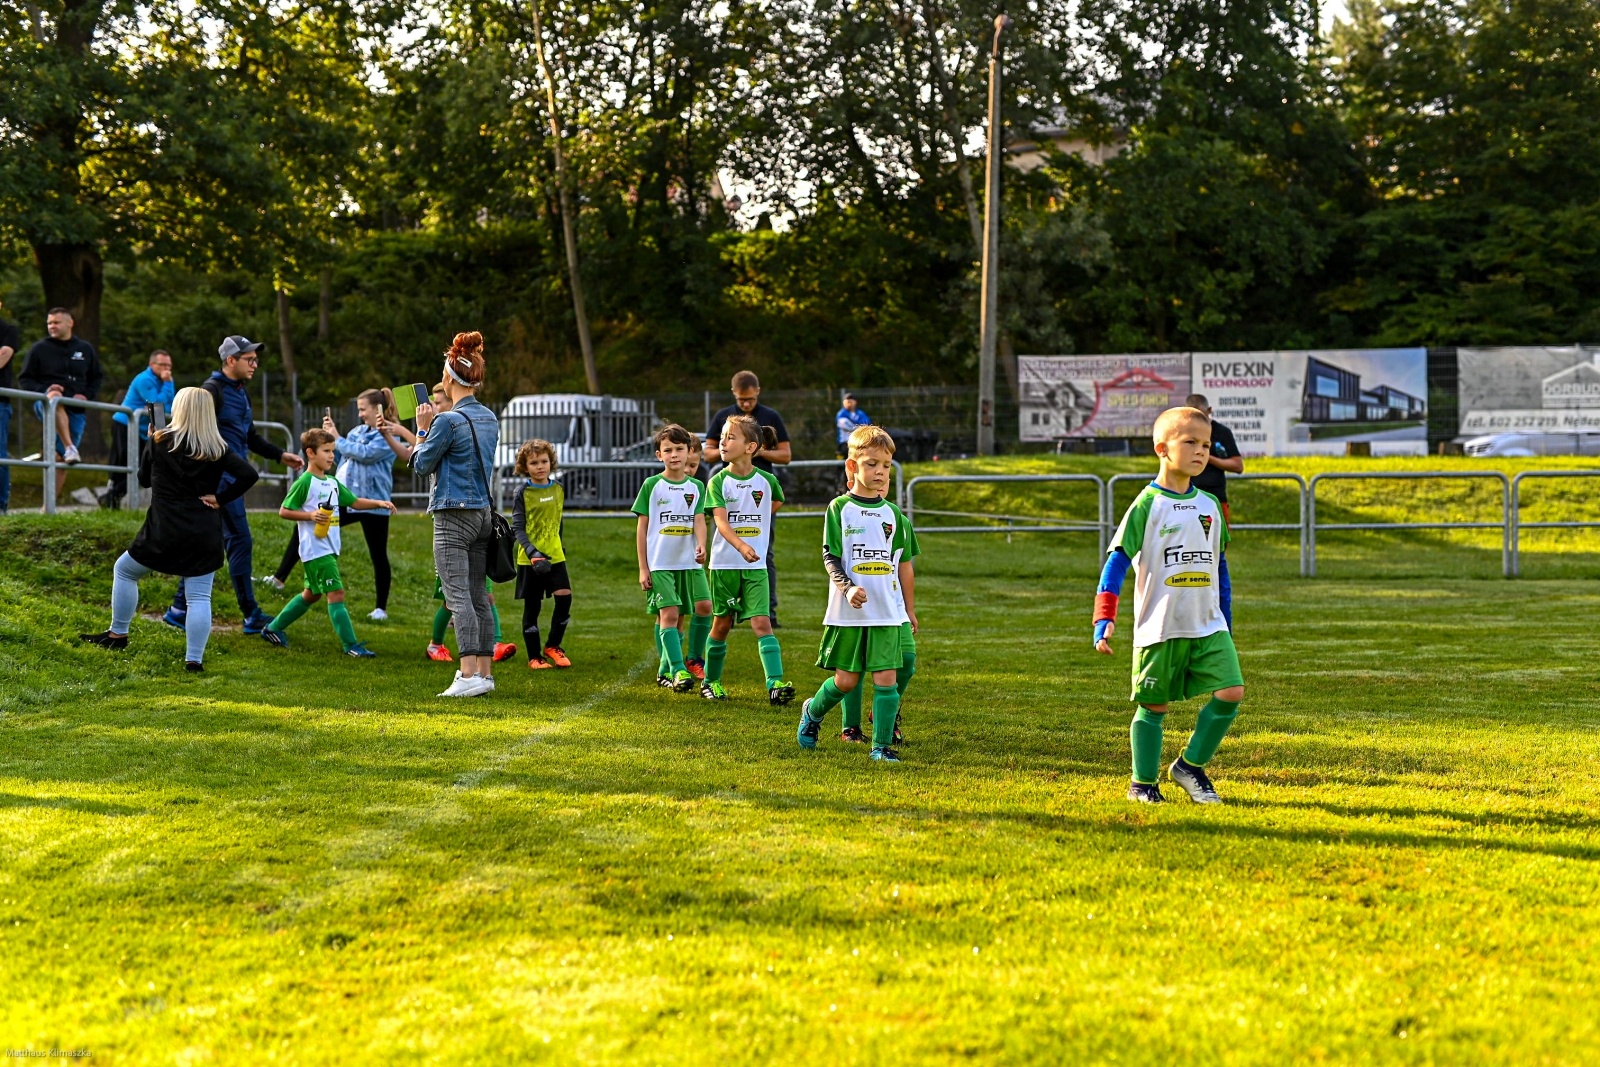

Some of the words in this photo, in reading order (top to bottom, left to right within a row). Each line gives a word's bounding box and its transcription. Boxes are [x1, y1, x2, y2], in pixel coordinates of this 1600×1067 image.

[1202, 362, 1274, 377] PIVEXIN
[1203, 378, 1274, 388] TECHNOLOGY
[1219, 396, 1258, 406] DOSTAWCA
